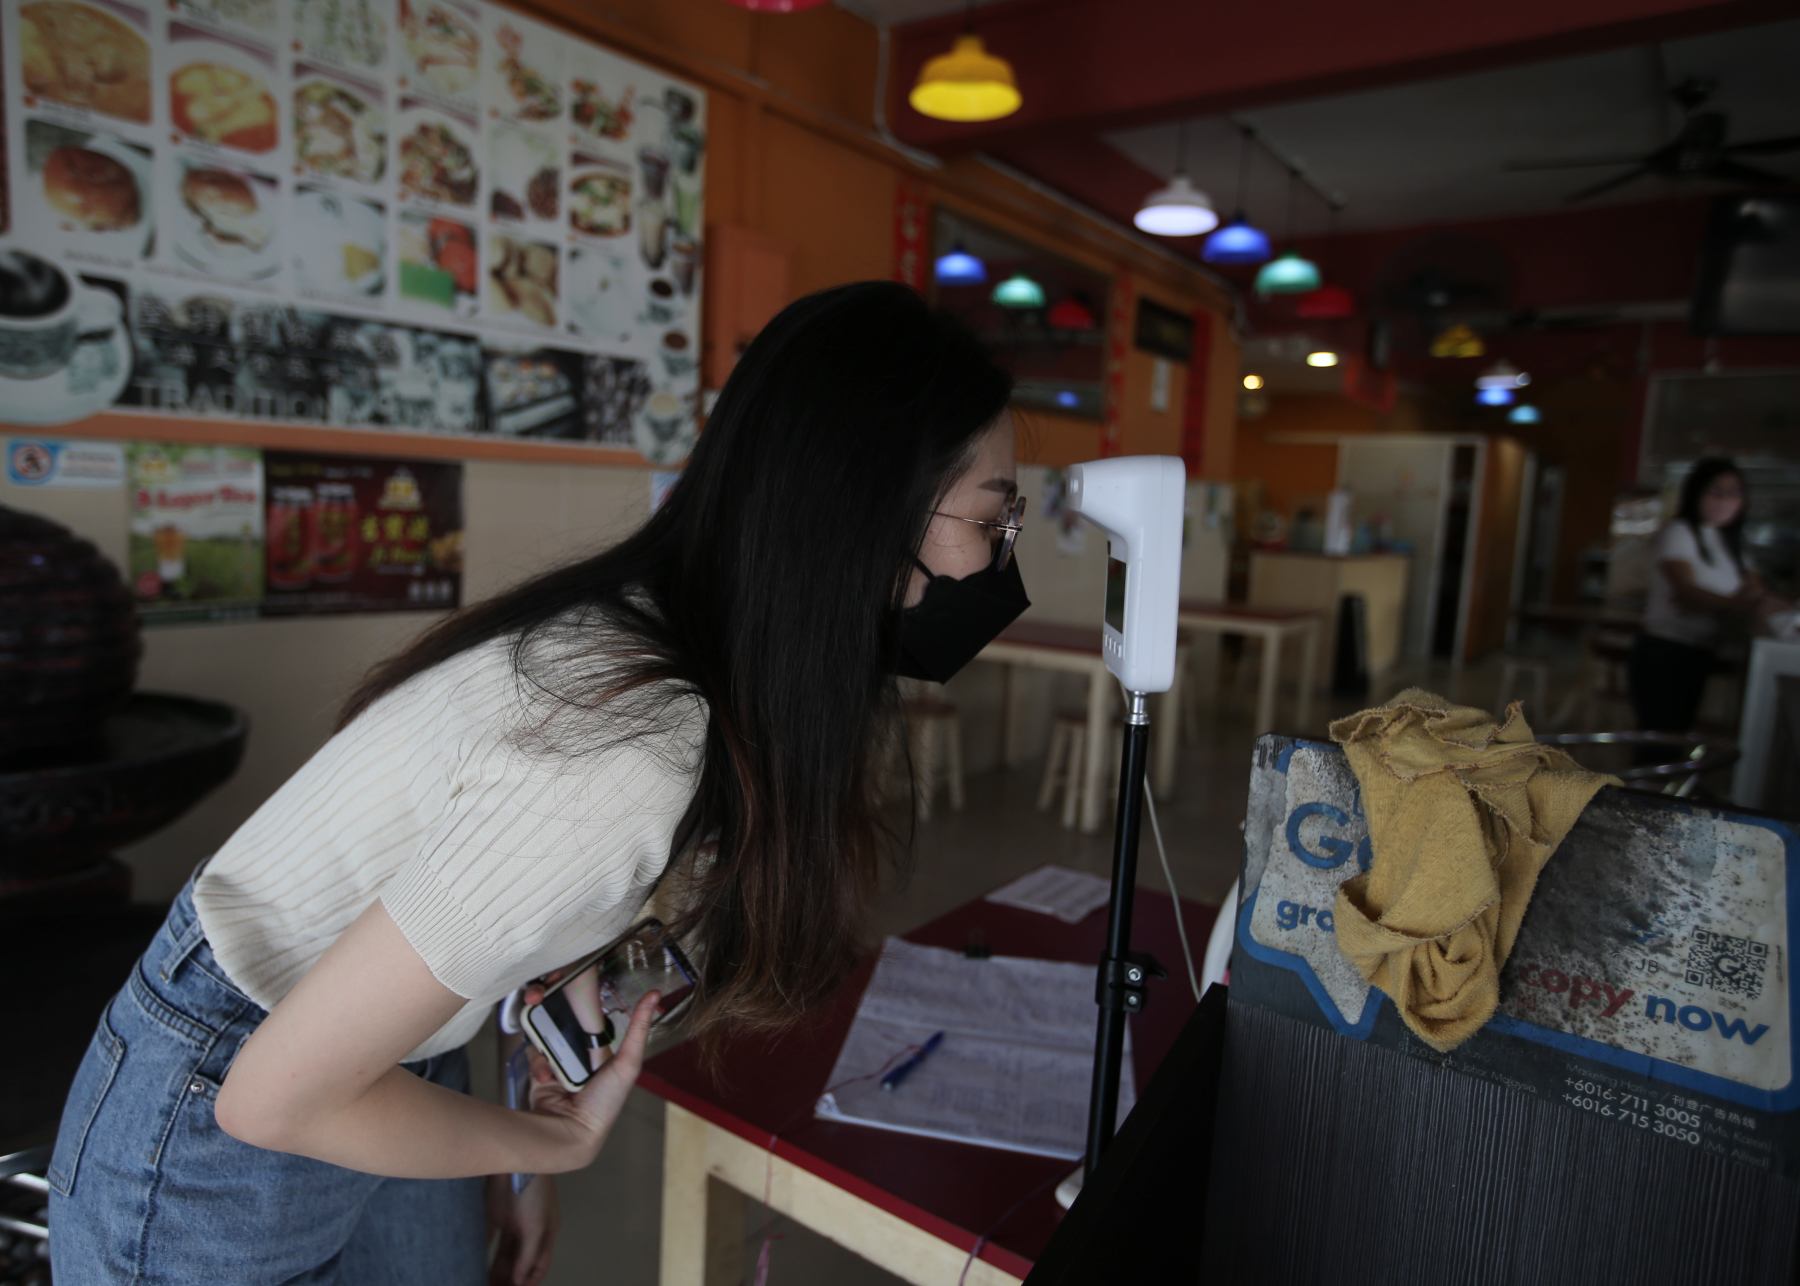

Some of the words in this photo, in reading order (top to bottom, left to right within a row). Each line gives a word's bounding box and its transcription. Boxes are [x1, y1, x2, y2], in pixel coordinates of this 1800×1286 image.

[1519, 964, 1636, 1018] copy
[1644, 994, 1771, 1046] now
[1565, 1063, 1618, 1088] Marketing
[1620, 1079, 1658, 1098] Hotline
[1653, 1103, 1702, 1128] 3005
[1652, 1119, 1702, 1145] 3050
